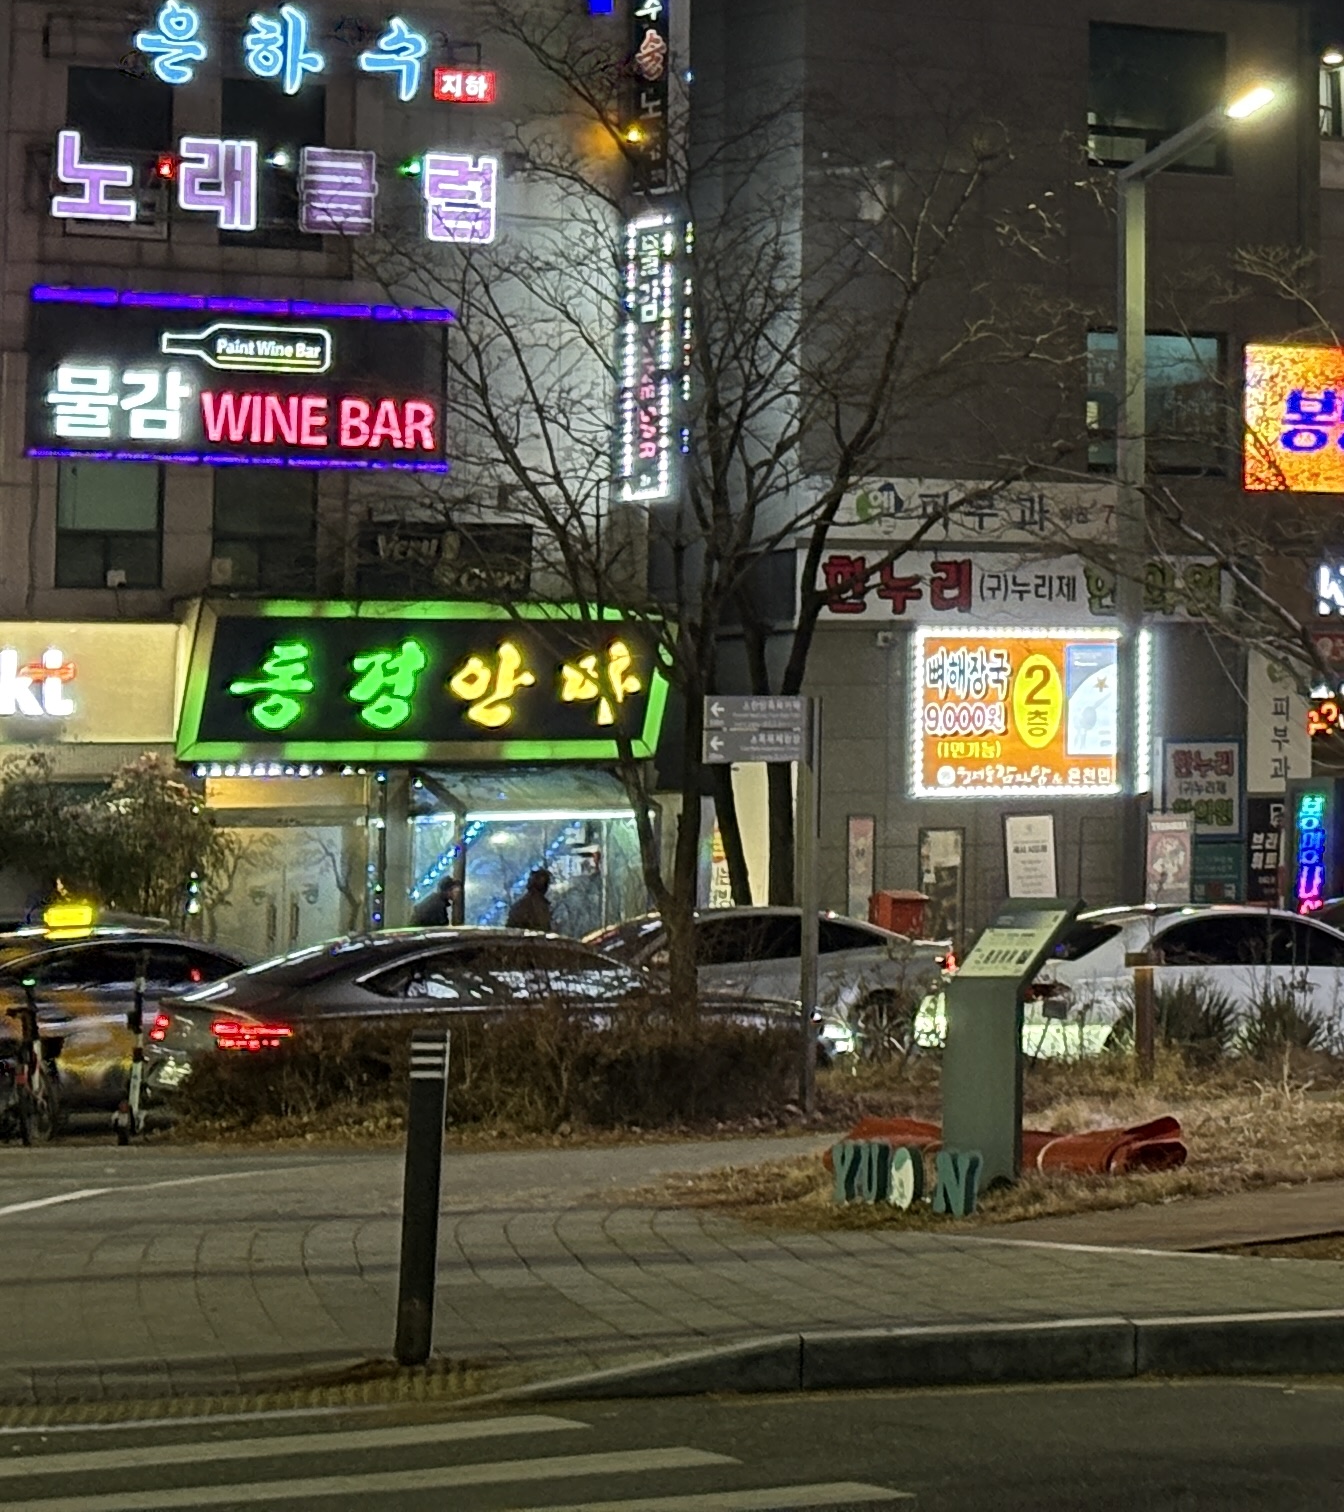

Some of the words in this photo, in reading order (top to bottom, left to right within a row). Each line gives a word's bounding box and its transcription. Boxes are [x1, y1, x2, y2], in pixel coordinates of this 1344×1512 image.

[441, 73, 489, 99] 지하
[216, 338, 254, 356] Paint
[255, 340, 293, 358] Wine
[295, 343, 322, 359] Bar
[48, 365, 190, 440] 물감
[200, 391, 329, 446] WINE
[338, 398, 437, 450] BAR
[823, 554, 972, 614] 한누리
